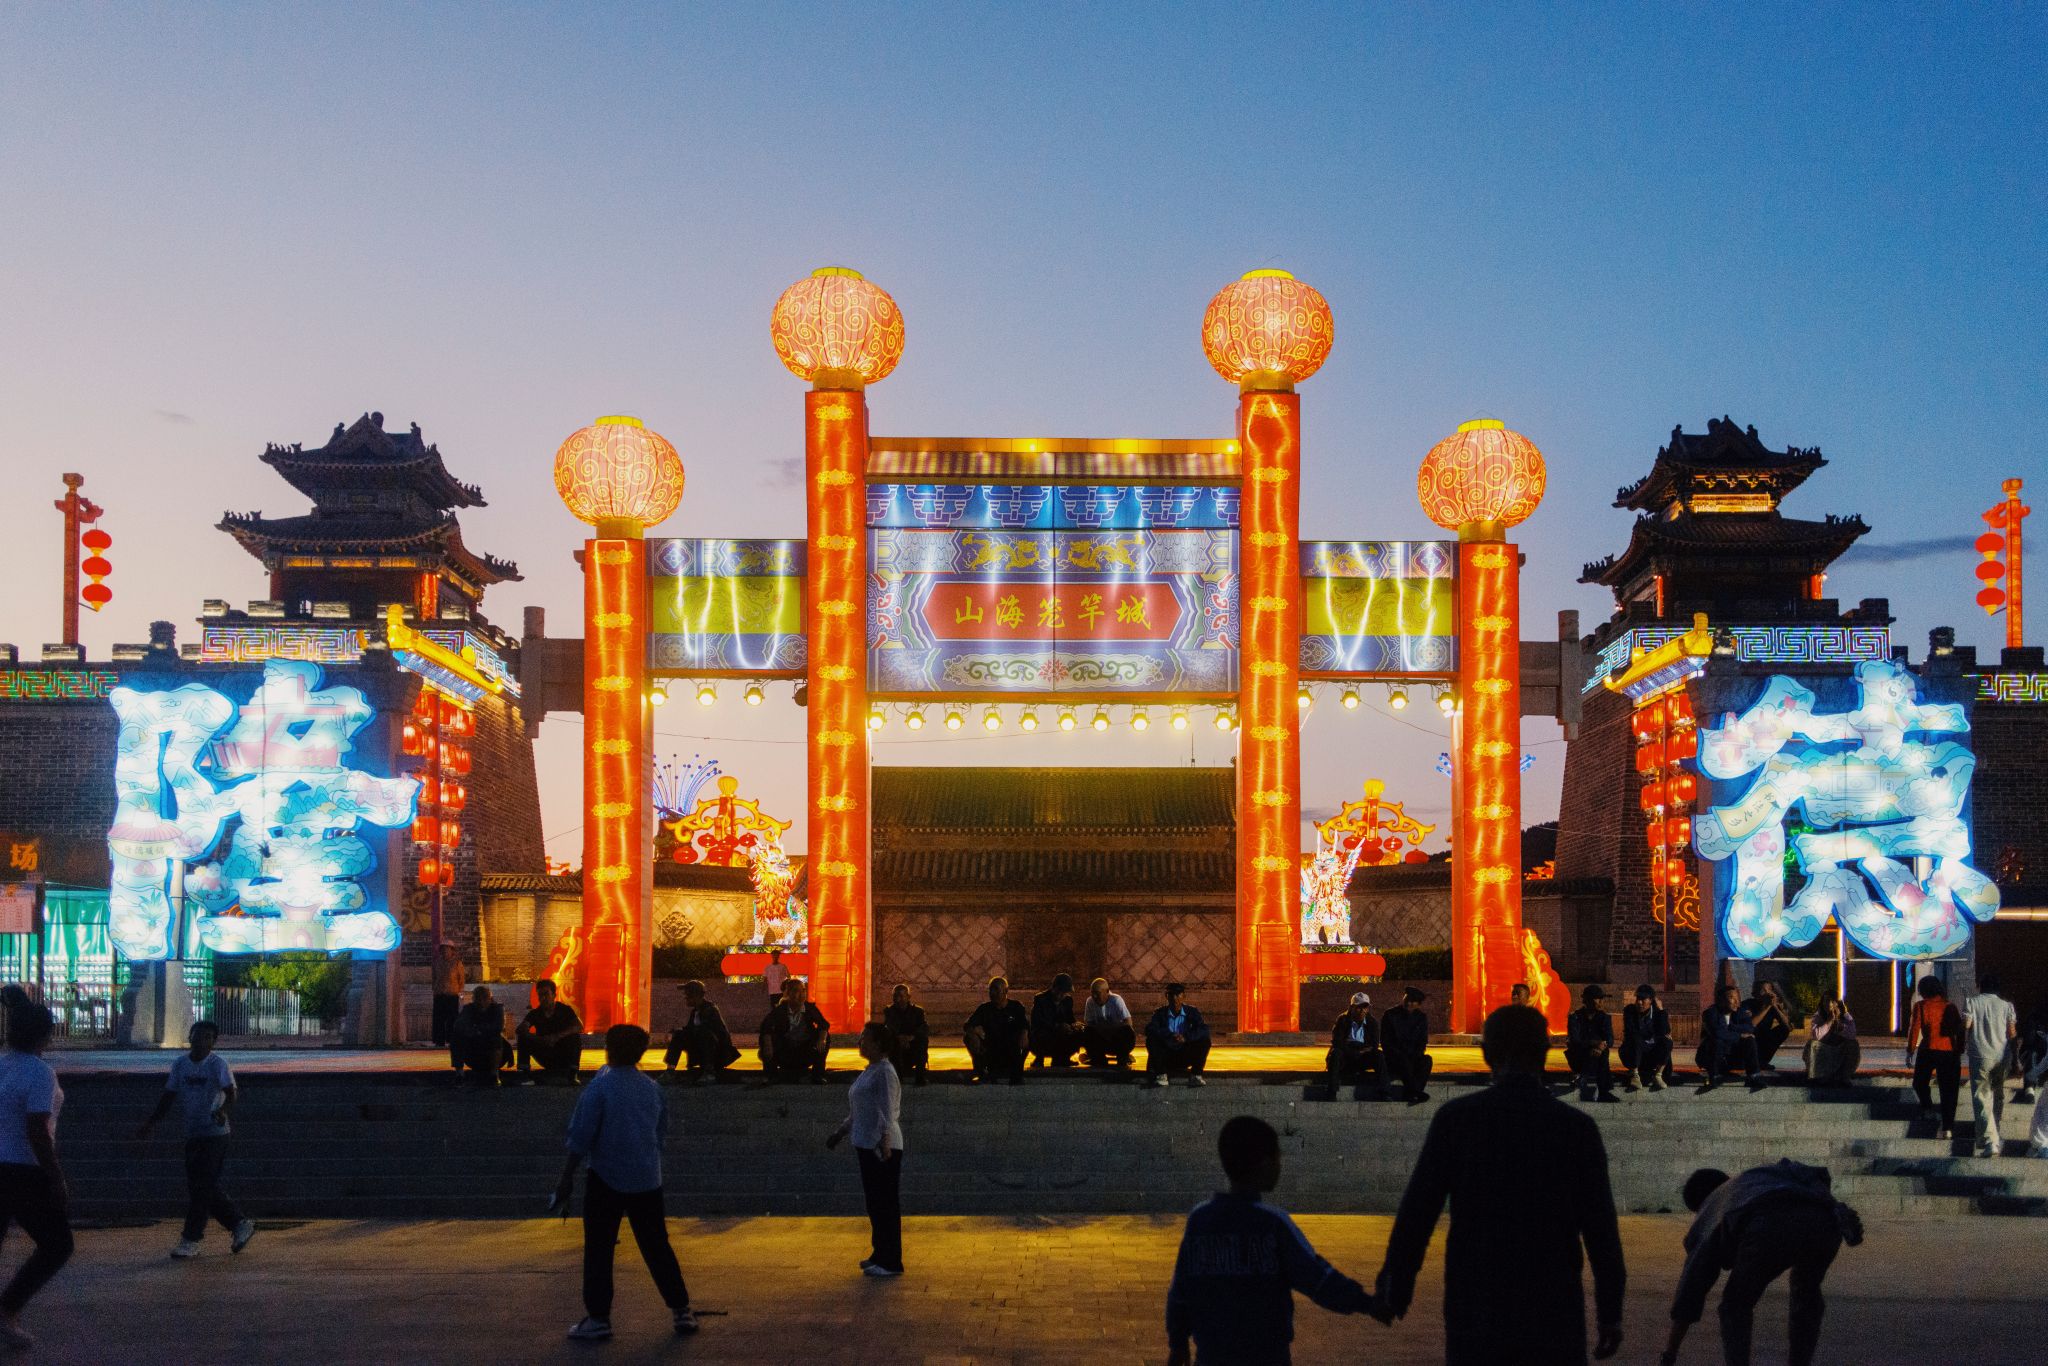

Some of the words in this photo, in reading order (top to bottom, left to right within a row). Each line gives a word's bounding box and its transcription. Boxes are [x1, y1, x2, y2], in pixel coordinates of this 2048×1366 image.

[9, 842, 39, 872] 场
[109, 659, 421, 960] 隆
[1693, 658, 2001, 960] 德
